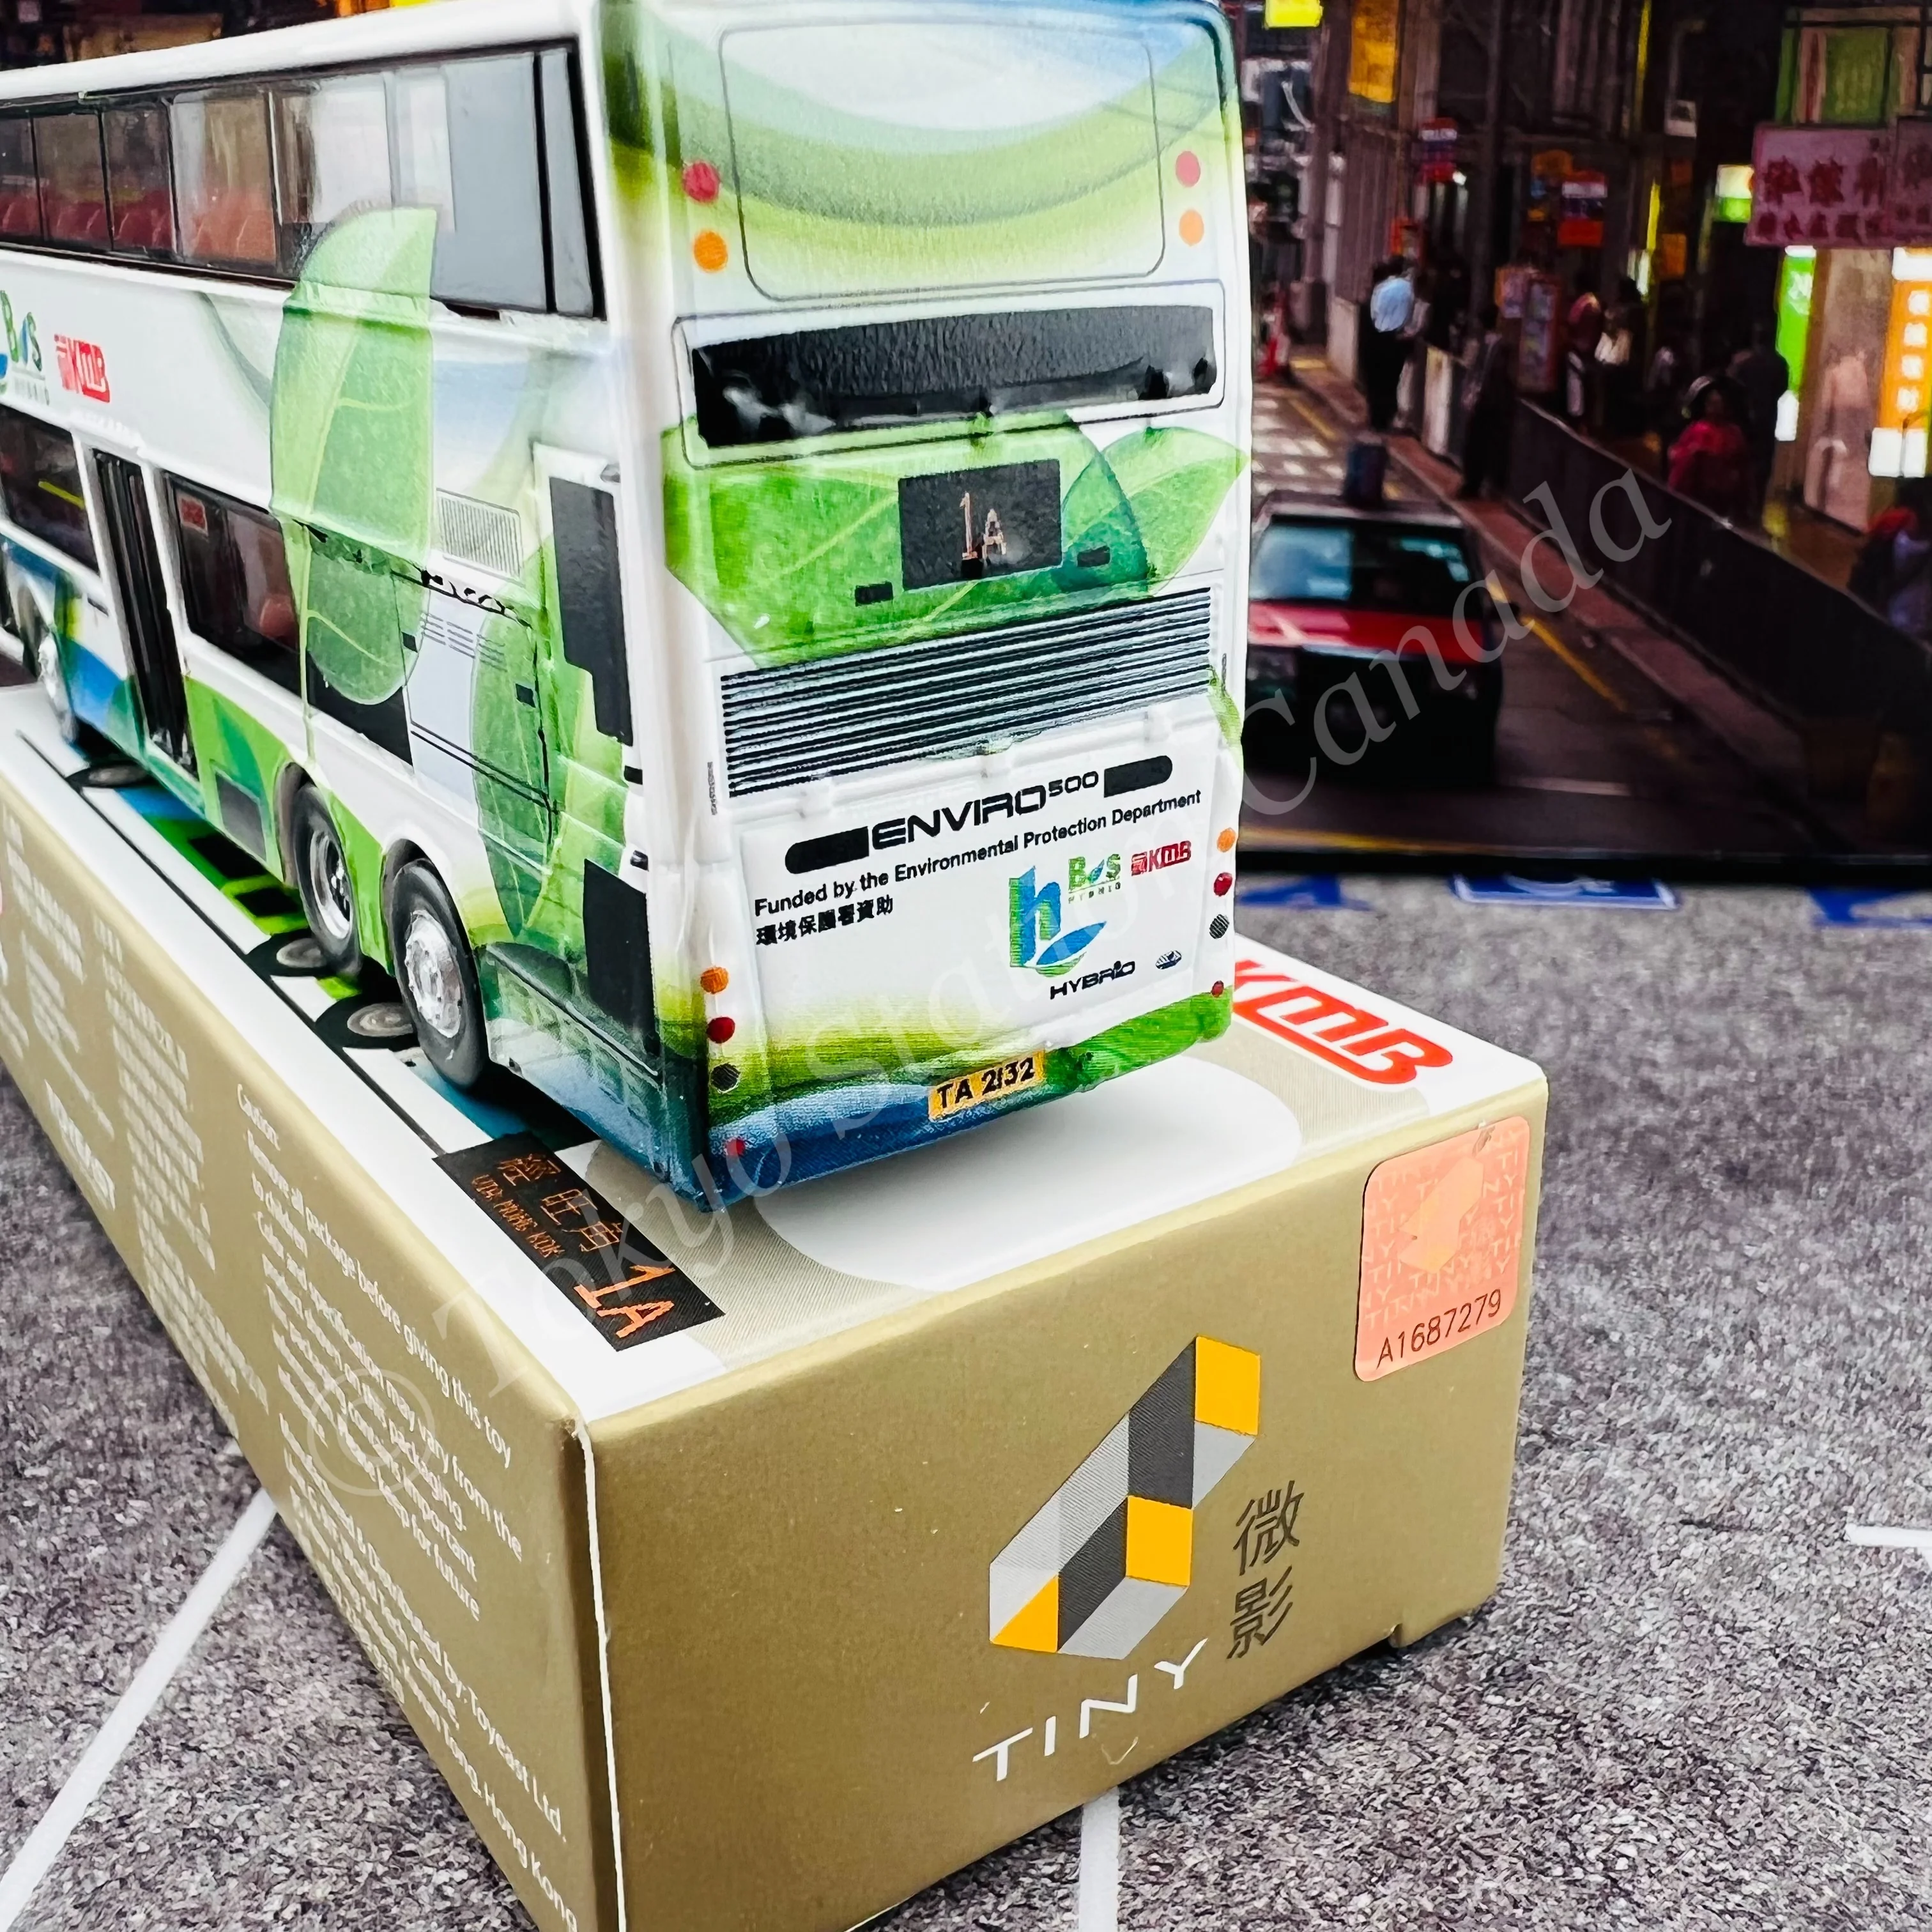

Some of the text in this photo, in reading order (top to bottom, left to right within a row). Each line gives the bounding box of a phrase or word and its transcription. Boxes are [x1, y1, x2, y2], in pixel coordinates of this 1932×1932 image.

[960, 491, 1007, 560] 1A
[755, 790, 1202, 916] Funded by the Environmental Protection Department
[937, 1057, 1036, 1108] TA 2132
[305, 1208, 356, 1278] package
[357, 1261, 401, 1333] before
[403, 1325, 449, 1397] giving
[452, 1377, 481, 1429] this
[484, 1416, 511, 1468] toy
[574, 1264, 676, 1339] 1A
[1376, 1288, 1502, 1370] A1687279
[386, 1380, 415, 1431] may
[417, 1418, 449, 1473] vary
[452, 1455, 491, 1521] from
[493, 1509, 522, 1561] the
[402, 1469, 476, 1581] important
[411, 1514, 431, 1556] for
[434, 1544, 479, 1621] future
[1226, 1479, 1305, 1660] 微影
[468, 1687, 529, 1791] Toyeast
[533, 1776, 567, 1843] Ltd.
[972, 1637, 1208, 1782] TINY
[484, 1781, 528, 1869] Hong
[531, 1851, 578, 1932] Kong
